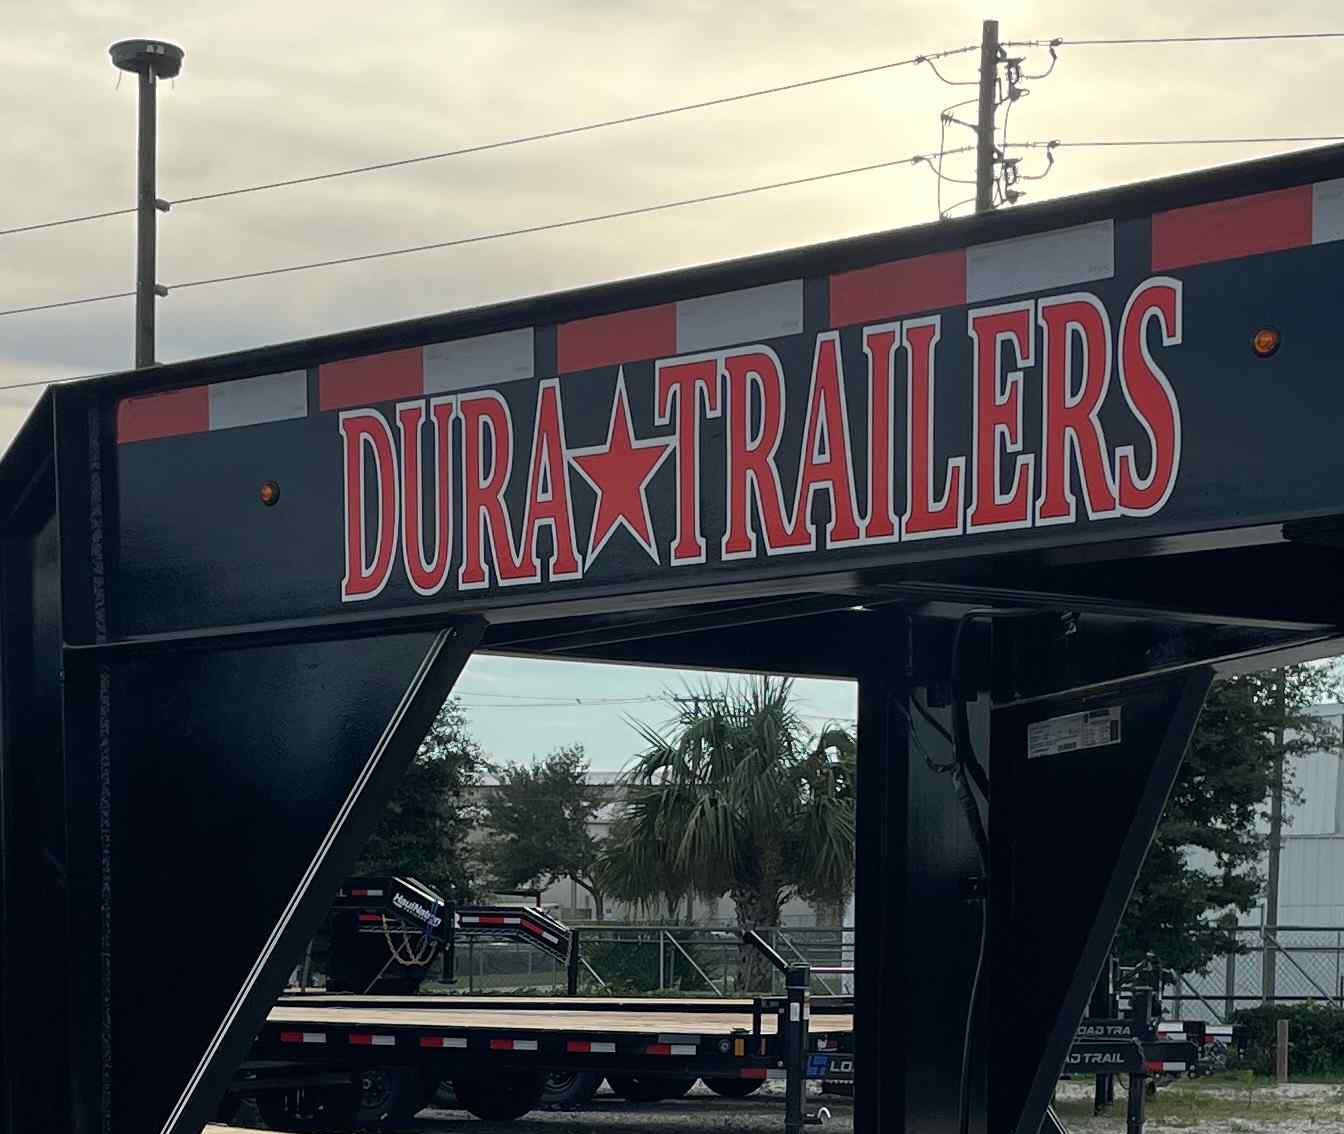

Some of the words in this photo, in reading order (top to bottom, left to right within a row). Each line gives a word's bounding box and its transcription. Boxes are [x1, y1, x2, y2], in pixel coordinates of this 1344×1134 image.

[339, 377, 584, 603] DURA
[654, 275, 1184, 567] TRAILERS
[1083, 1052, 1125, 1064] TRAIL
